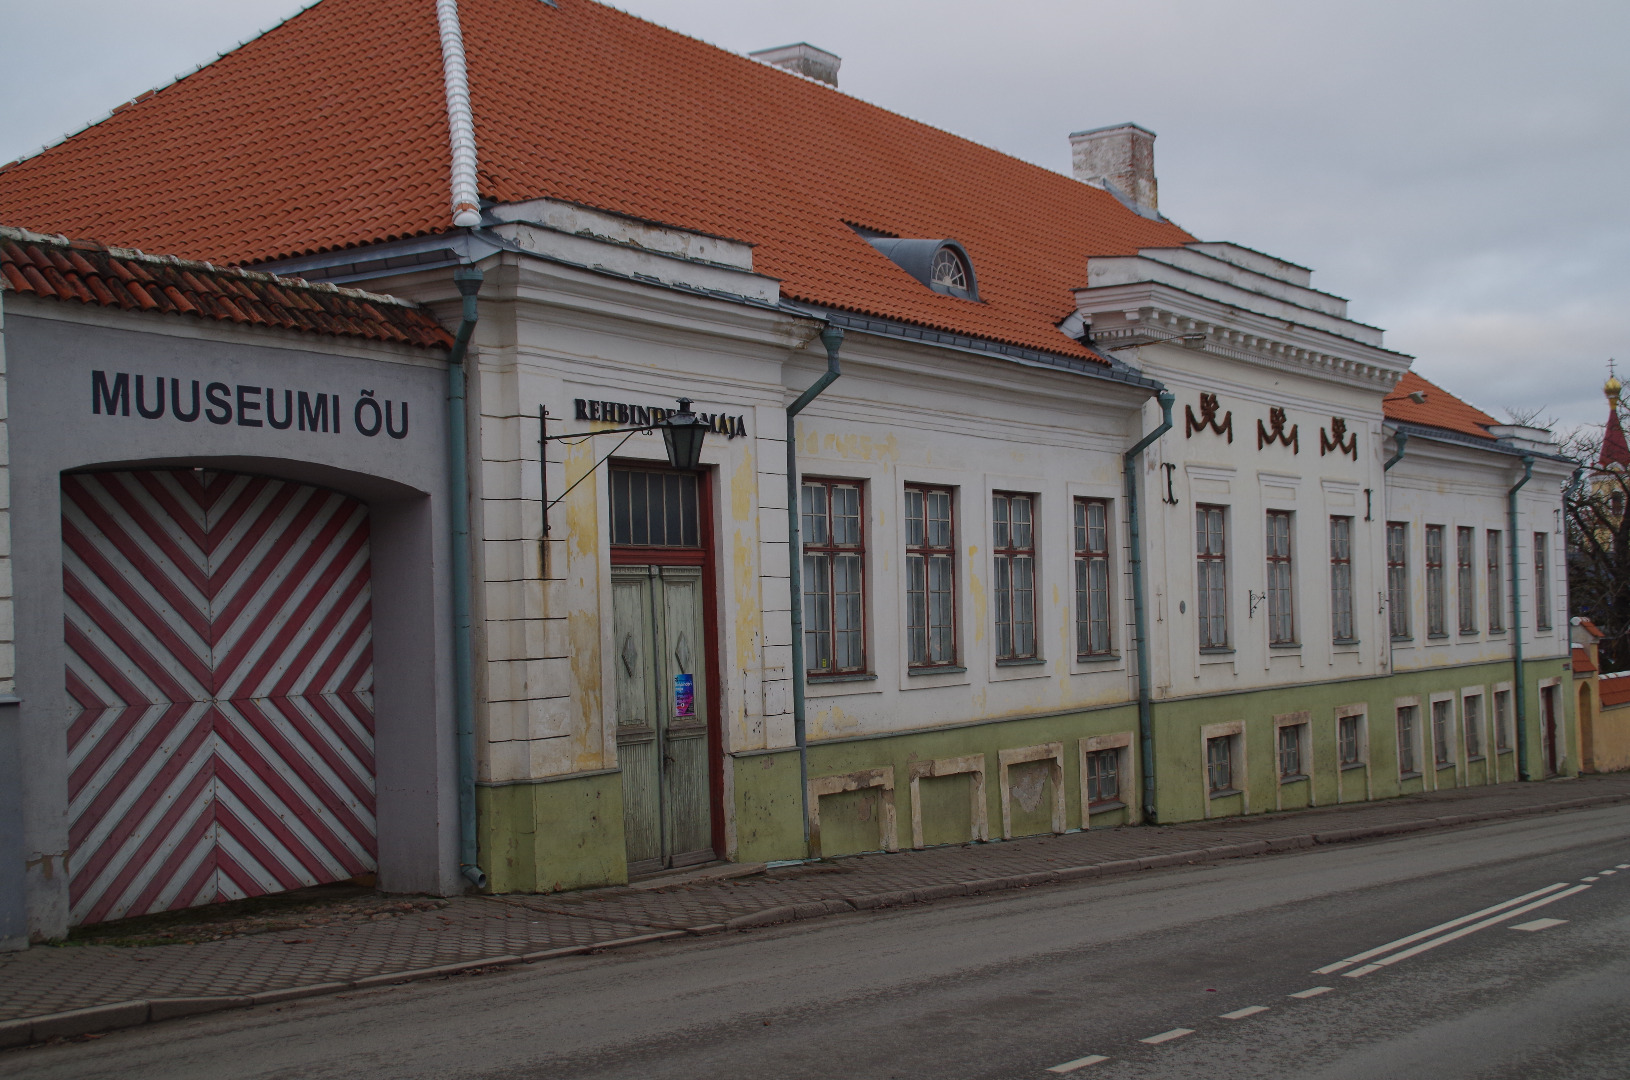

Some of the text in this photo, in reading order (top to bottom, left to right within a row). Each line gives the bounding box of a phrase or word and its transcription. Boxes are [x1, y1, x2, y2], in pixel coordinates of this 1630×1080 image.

[91, 369, 409, 439] MUUSEUMI ÕU
[575, 398, 694, 430] REHBINDE
